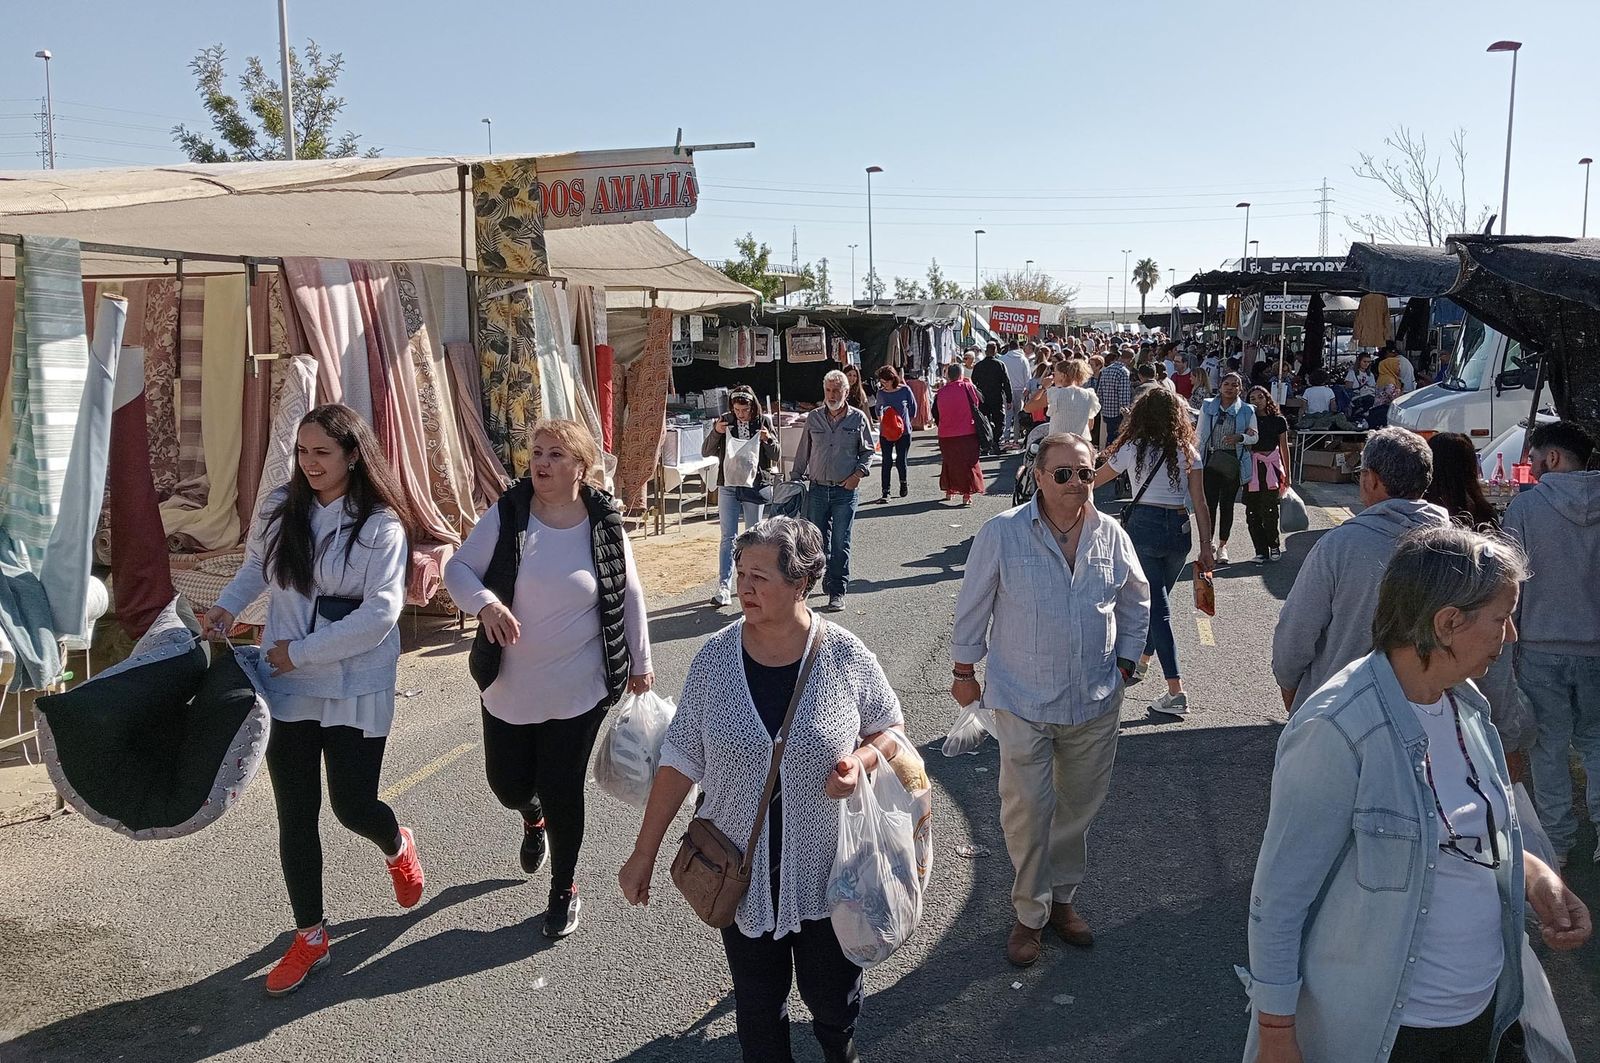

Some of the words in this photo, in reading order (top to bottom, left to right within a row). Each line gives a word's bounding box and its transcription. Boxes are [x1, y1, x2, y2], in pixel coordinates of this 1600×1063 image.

[591, 172, 698, 214] AMALIA
[1271, 261, 1346, 271] FACTORY
[992, 311, 1024, 322] RESTOS
[1027, 315, 1038, 324] DE
[999, 322, 1028, 333] TIENDA
